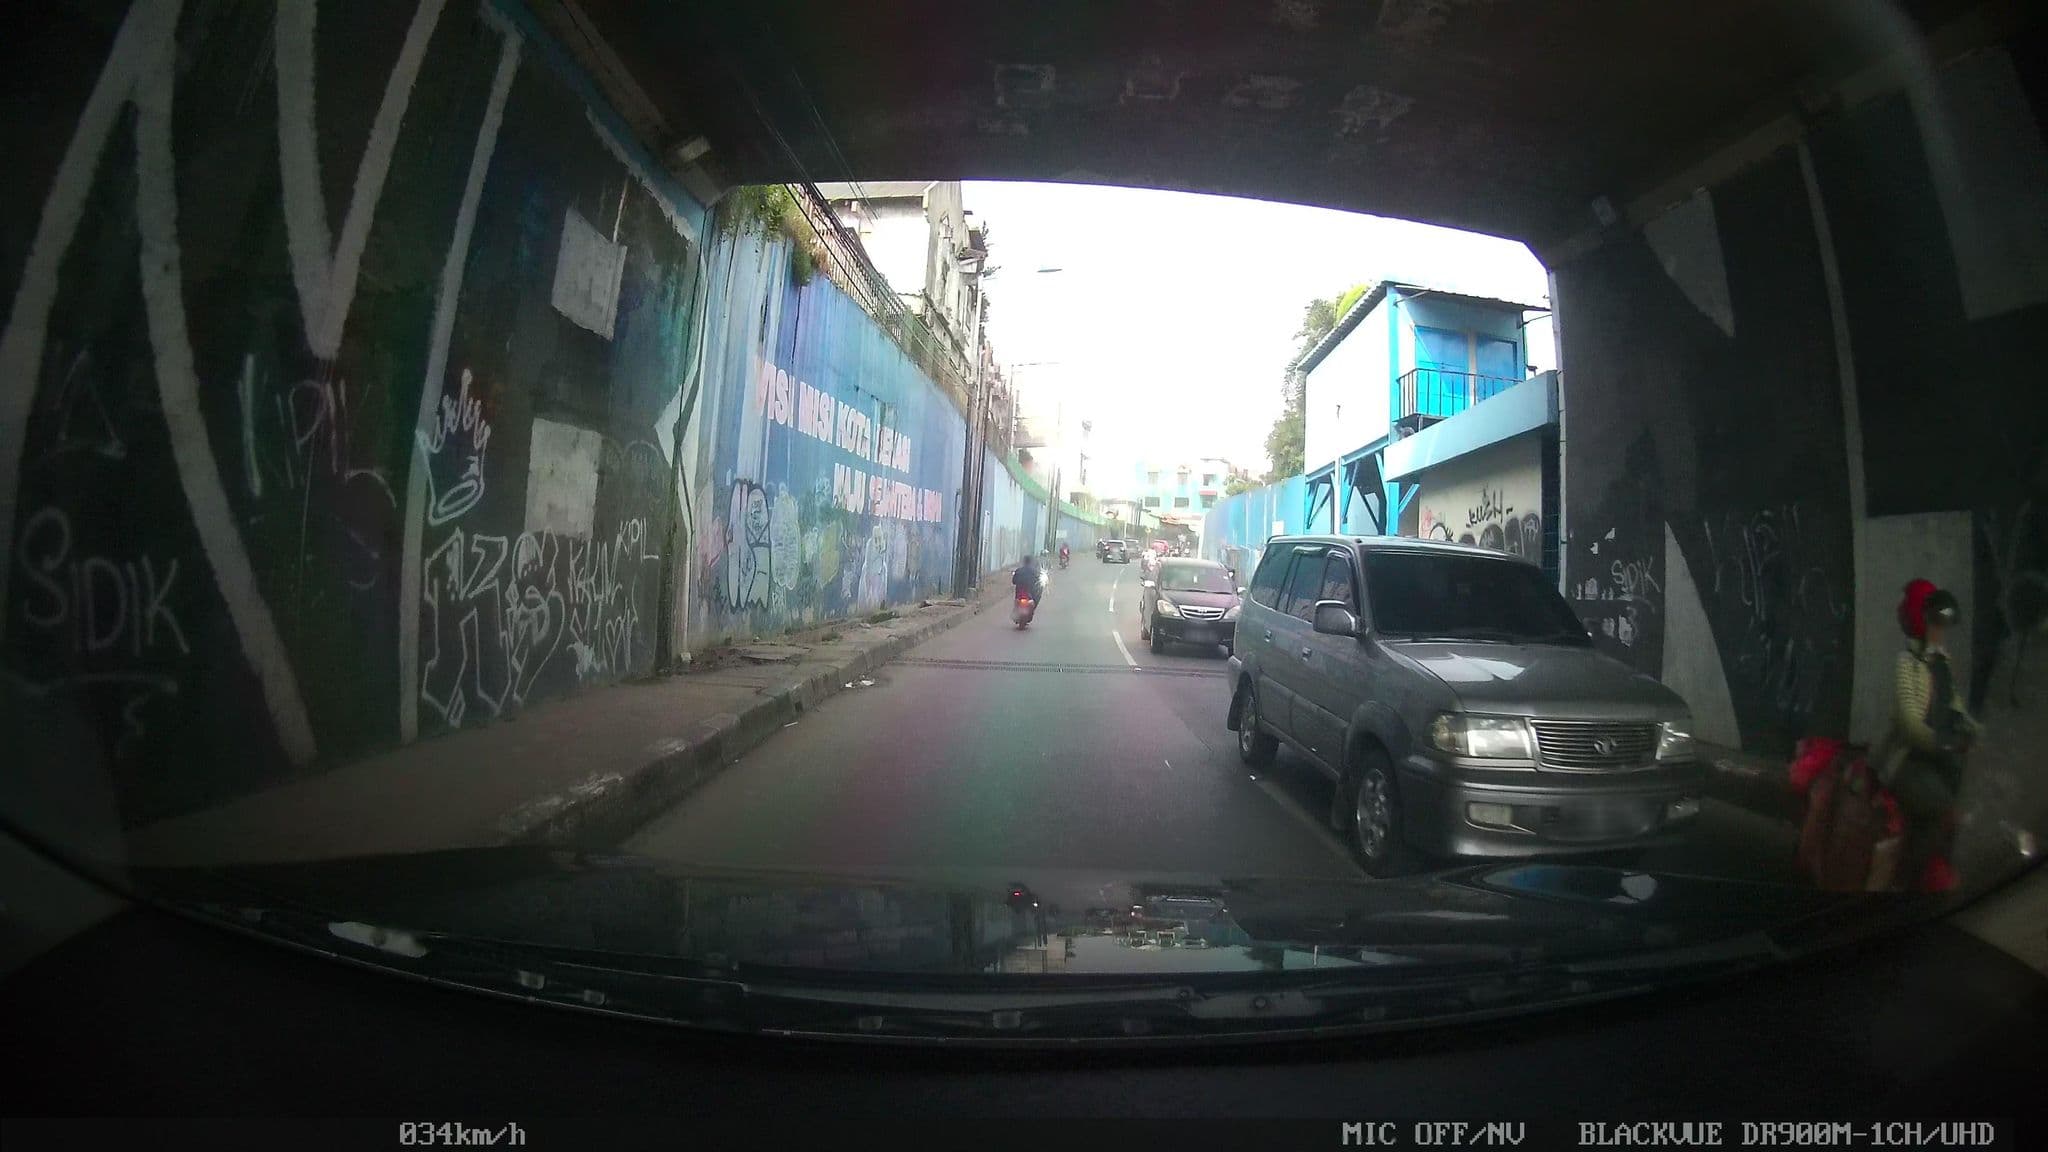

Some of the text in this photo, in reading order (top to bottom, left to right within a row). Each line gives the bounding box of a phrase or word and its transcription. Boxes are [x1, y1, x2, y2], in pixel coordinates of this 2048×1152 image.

[756, 361, 796, 428] VISI
[798, 381, 835, 444] MISI
[836, 401, 871, 460] KOTA
[19, 506, 191, 656] SIDIK
[1610, 555, 1661, 598] SIDIK
